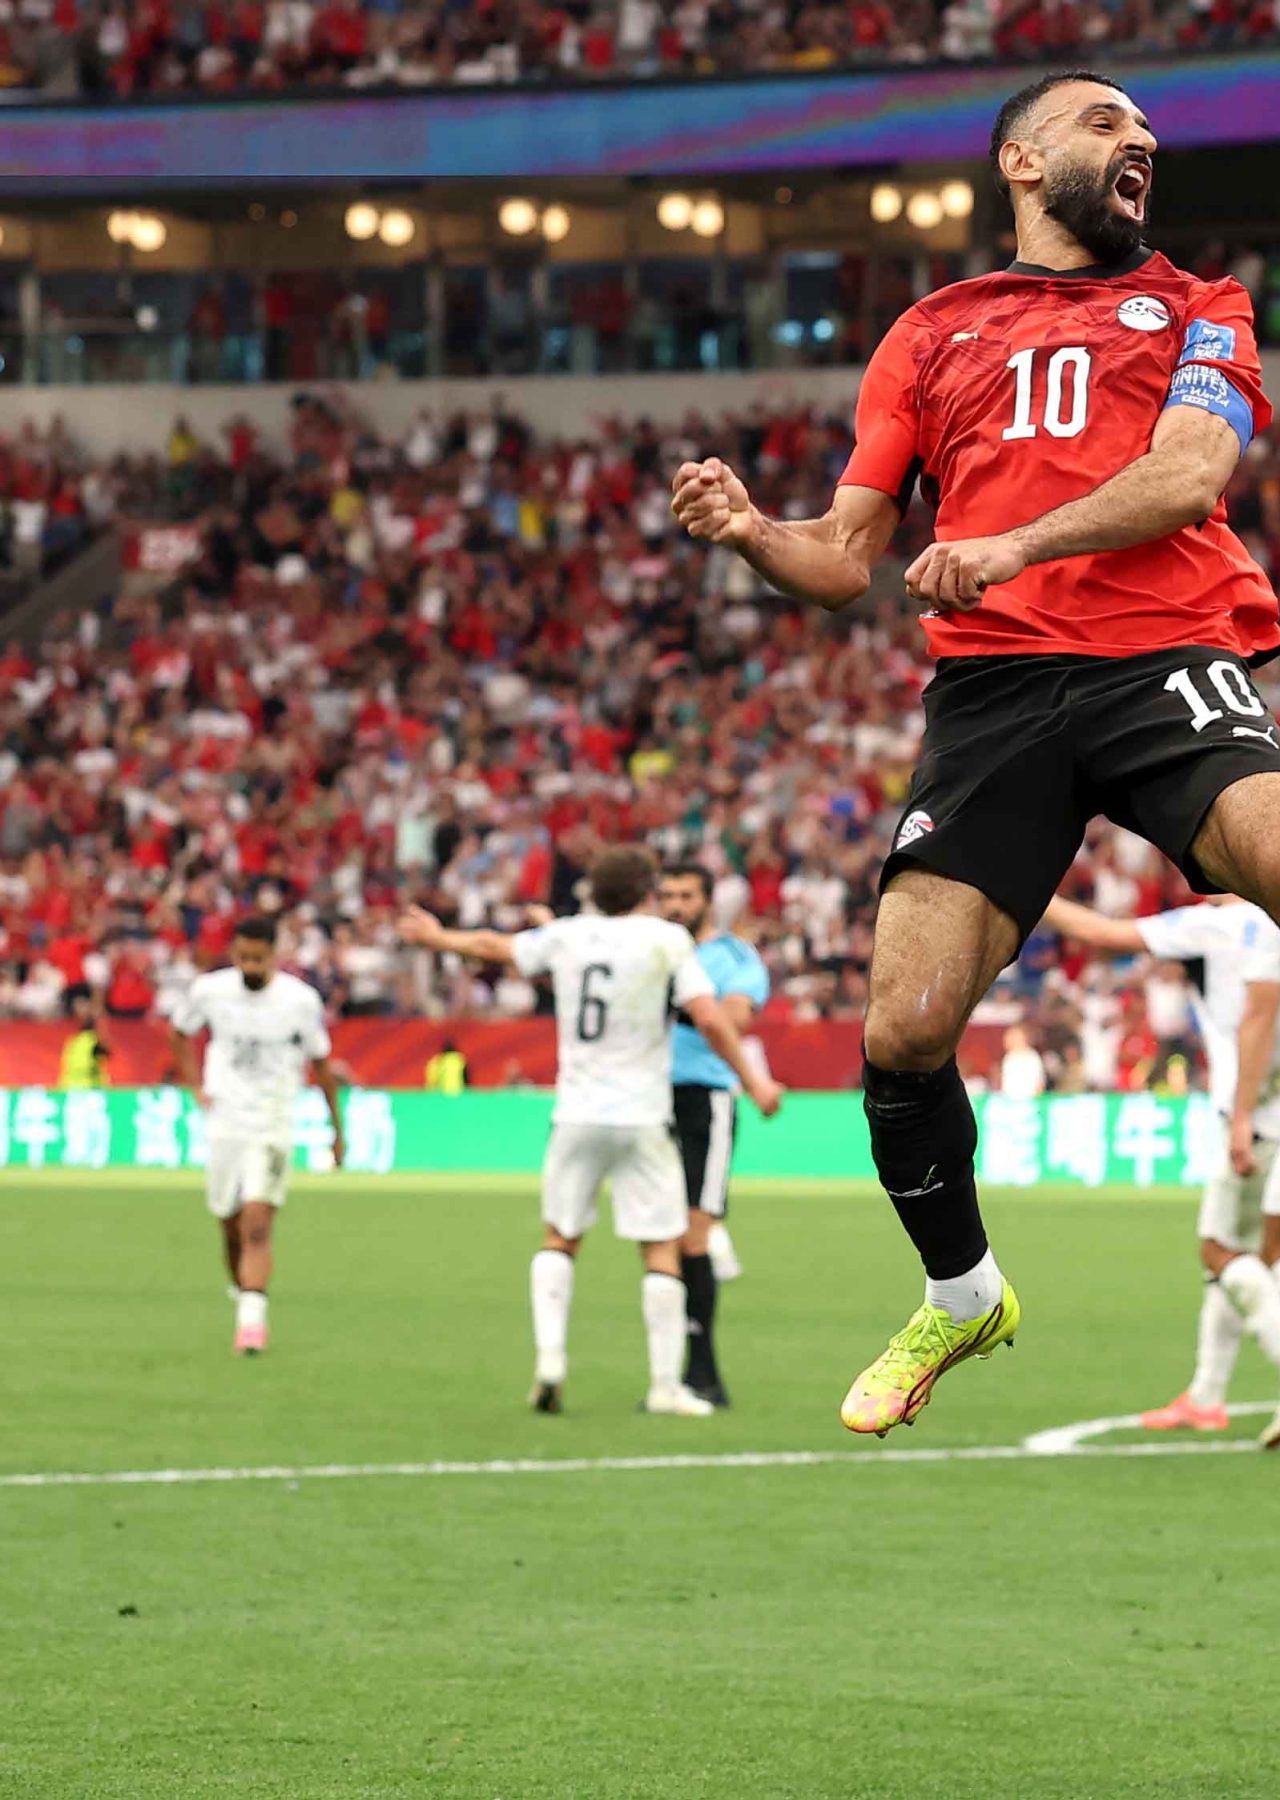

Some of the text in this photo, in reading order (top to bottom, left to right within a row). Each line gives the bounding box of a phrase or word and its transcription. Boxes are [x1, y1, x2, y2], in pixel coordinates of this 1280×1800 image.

[1002, 346, 1091, 441] 10
[1171, 371, 1228, 398] UNITES
[1163, 660, 1265, 732] 10
[578, 963, 613, 1042] 6
